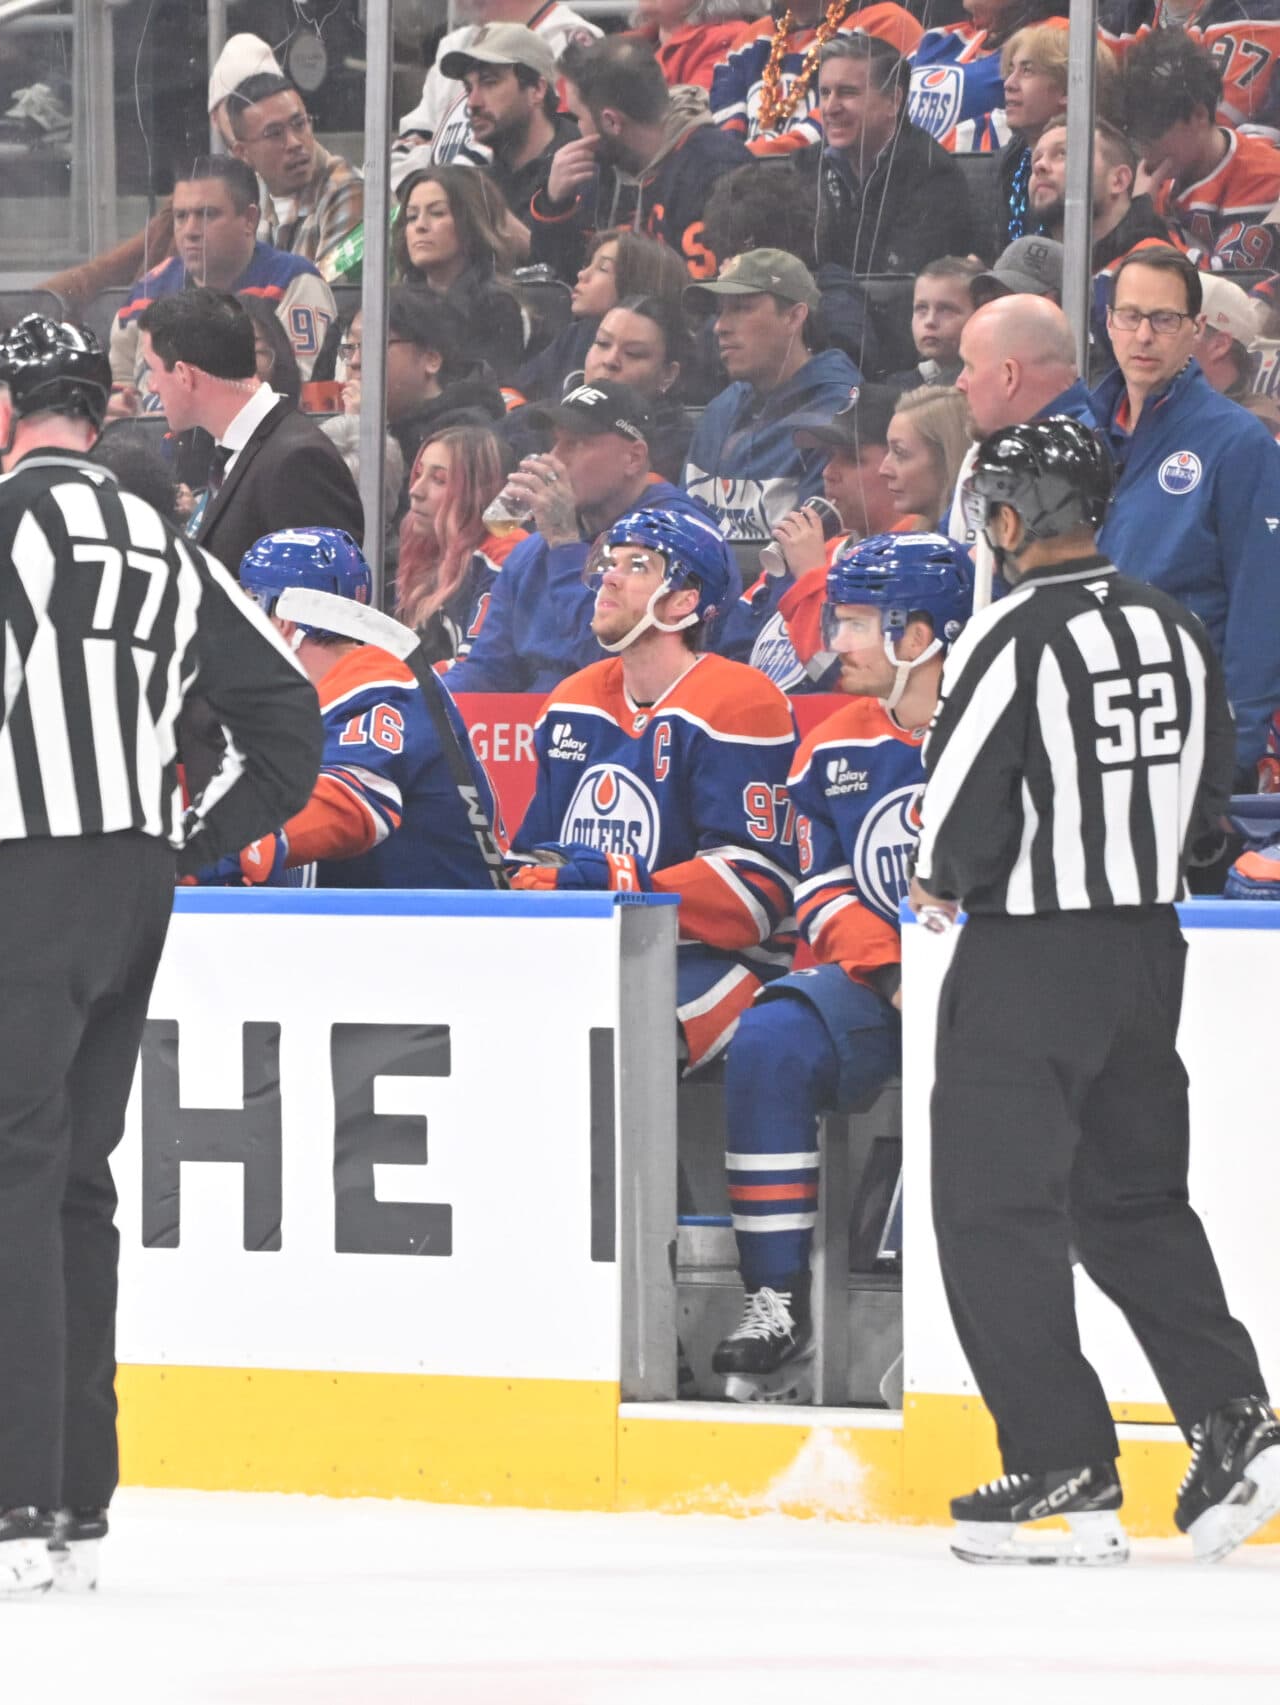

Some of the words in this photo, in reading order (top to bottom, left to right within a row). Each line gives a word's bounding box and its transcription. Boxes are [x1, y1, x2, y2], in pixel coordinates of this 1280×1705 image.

[72, 543, 170, 641] 77
[339, 702, 406, 755] 16
[559, 737, 588, 750] play
[1092, 671, 1182, 765] 52
[653, 721, 672, 783] C
[837, 769, 869, 784] play
[742, 781, 797, 846] 97
[824, 782, 869, 797] alberta
[572, 817, 643, 856] OILERS
[1028, 1467, 1092, 1519] CCM
